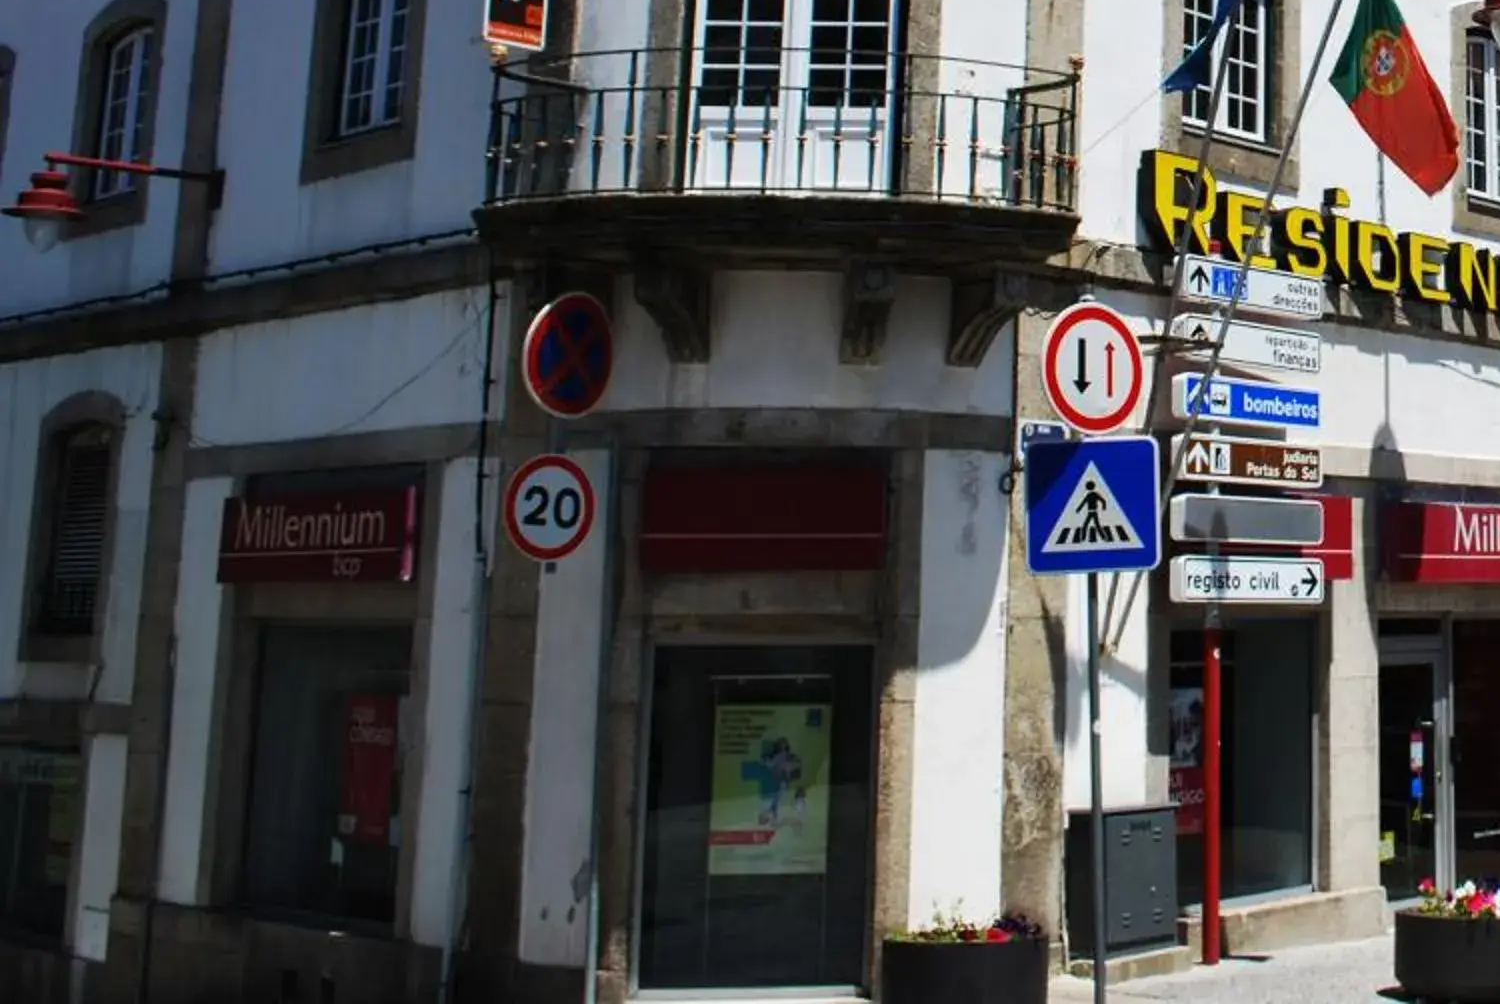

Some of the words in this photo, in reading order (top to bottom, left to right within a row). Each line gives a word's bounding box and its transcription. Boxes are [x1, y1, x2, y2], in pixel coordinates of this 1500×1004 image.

[1288, 282, 1319, 297] outras
[1243, 392, 1318, 419] bombeiros
[1246, 462, 1280, 478] Portas
[1301, 466, 1318, 481] Sol
[522, 485, 581, 530] 20
[234, 498, 386, 550] Millennium
[332, 551, 363, 578] bcp
[1187, 569, 1241, 593] registo
[1249, 571, 1280, 591] civil
